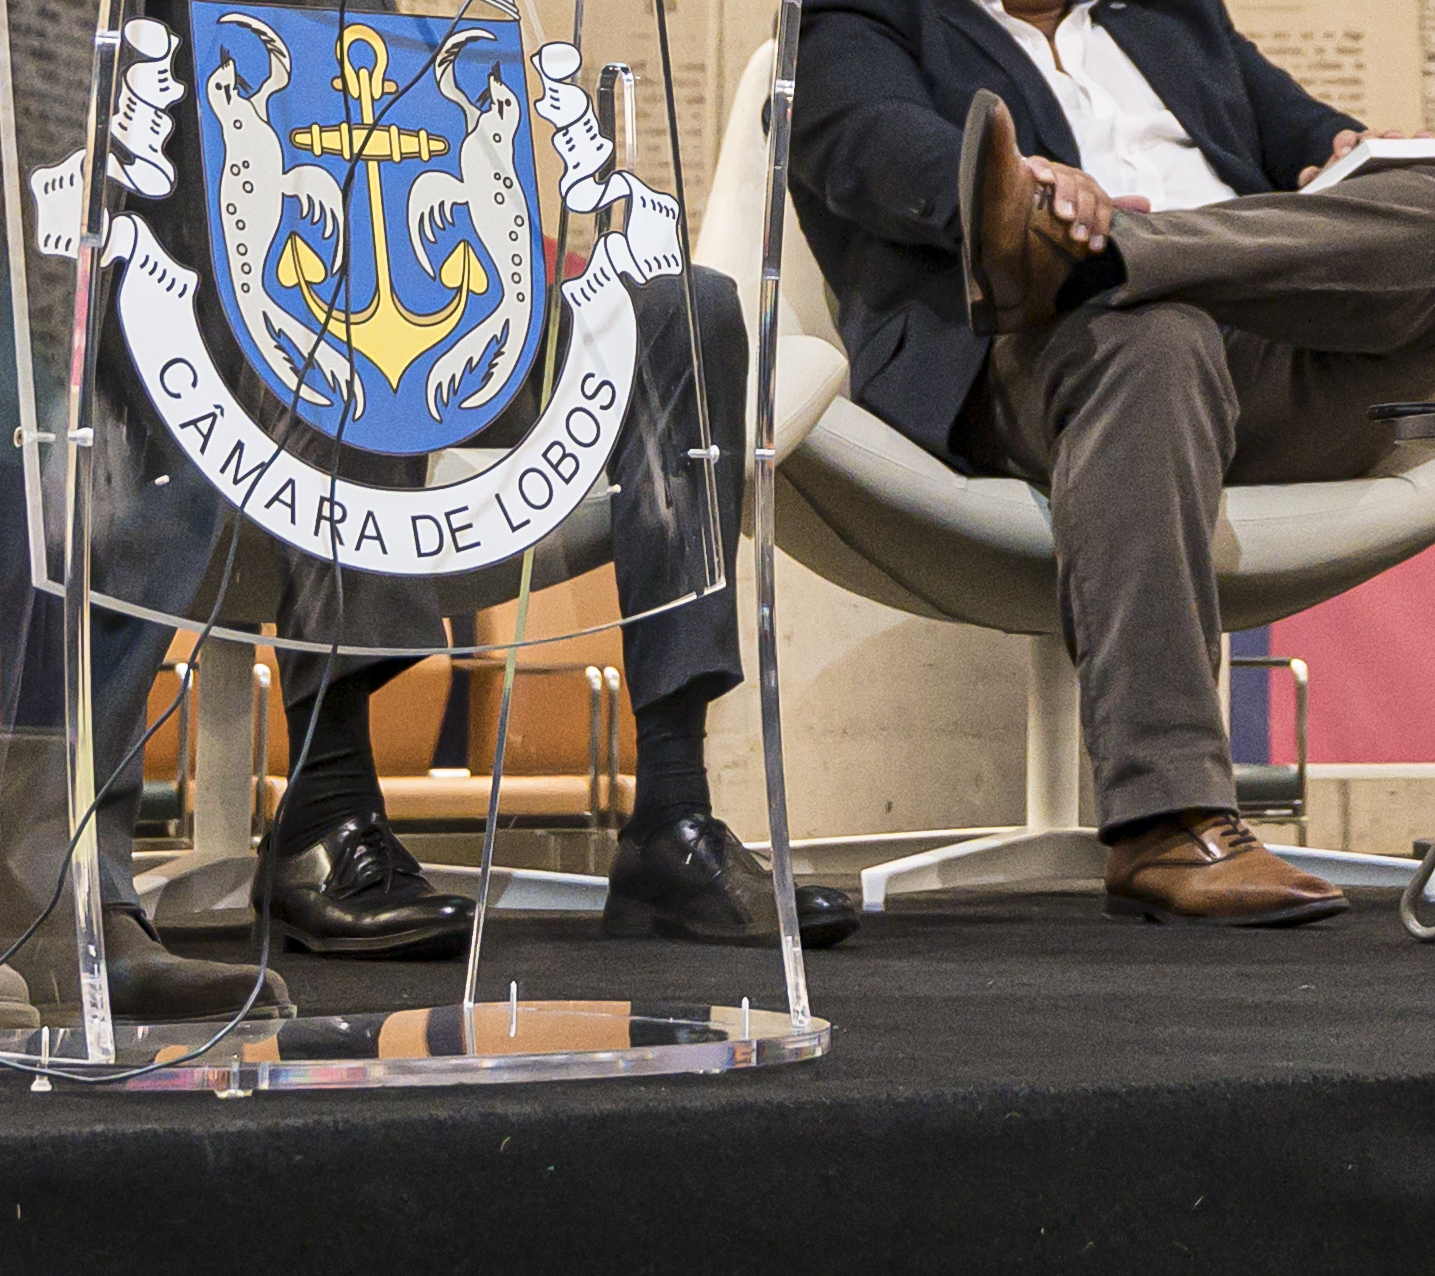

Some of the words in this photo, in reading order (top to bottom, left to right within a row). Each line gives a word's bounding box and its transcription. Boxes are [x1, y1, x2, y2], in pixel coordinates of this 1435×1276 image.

[157, 354, 389, 558] CÂMARA
[411, 505, 482, 560] DE
[494, 369, 621, 536] LOBOS
